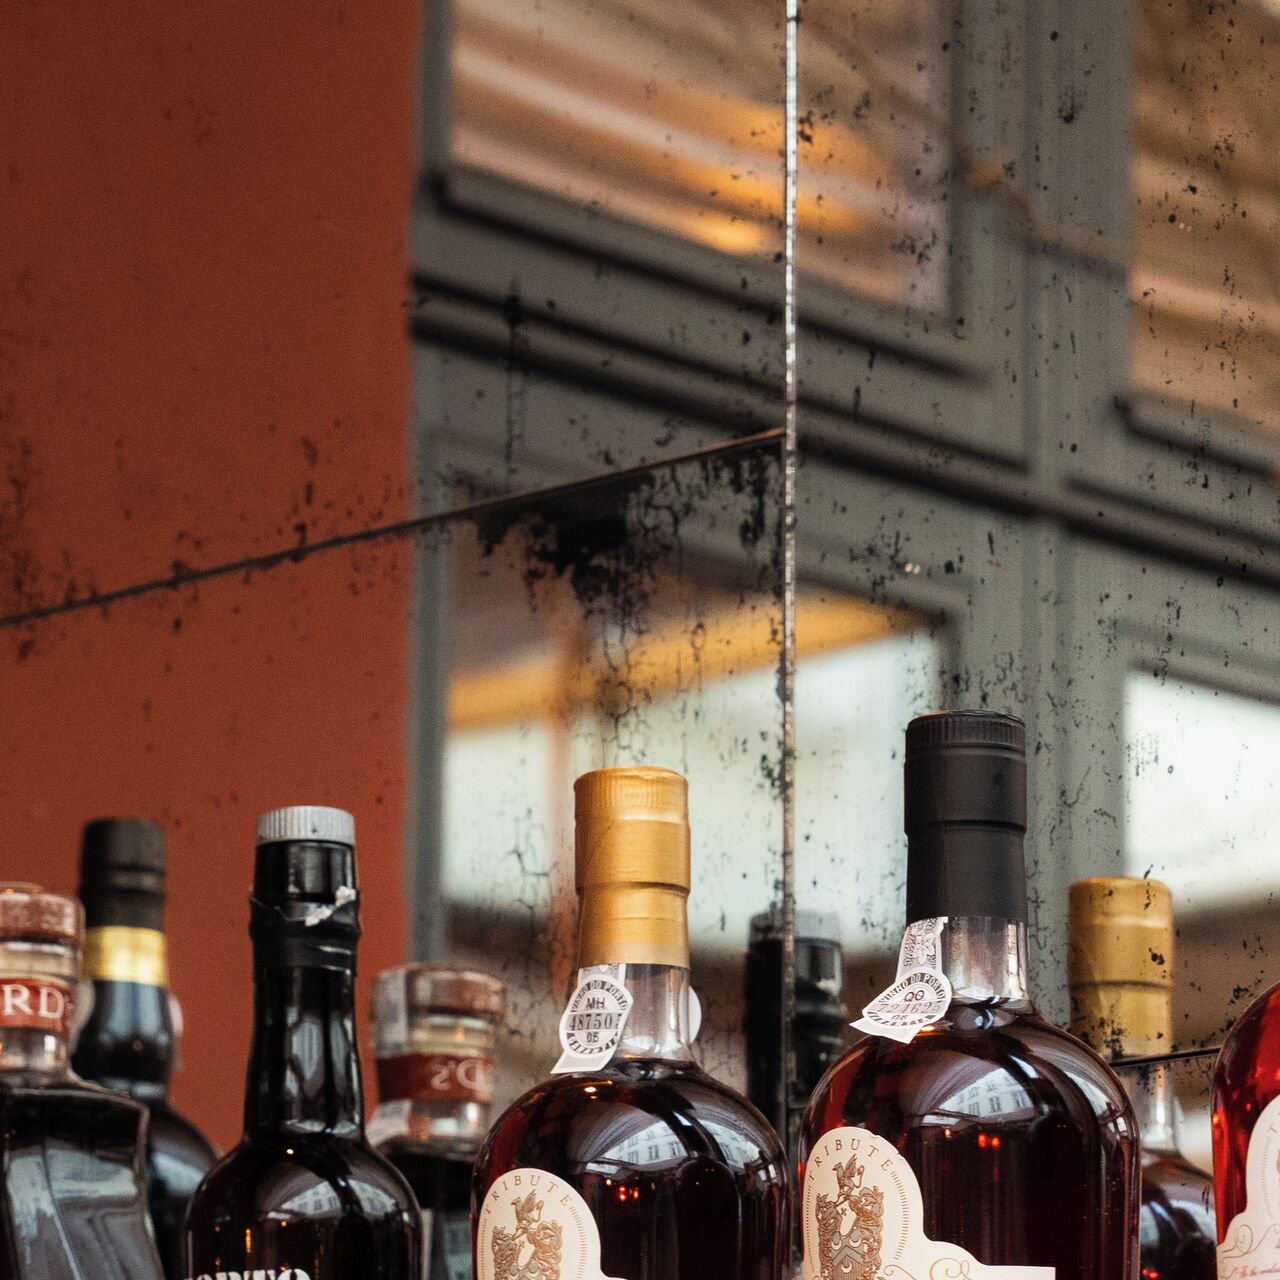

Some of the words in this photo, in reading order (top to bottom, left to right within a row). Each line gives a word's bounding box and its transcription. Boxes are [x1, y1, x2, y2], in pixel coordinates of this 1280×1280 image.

[923, 973, 946, 1001] PORTO
[809, 1138, 894, 1181] TRIBUTE
[484, 1174, 573, 1215] TRIBUTE
